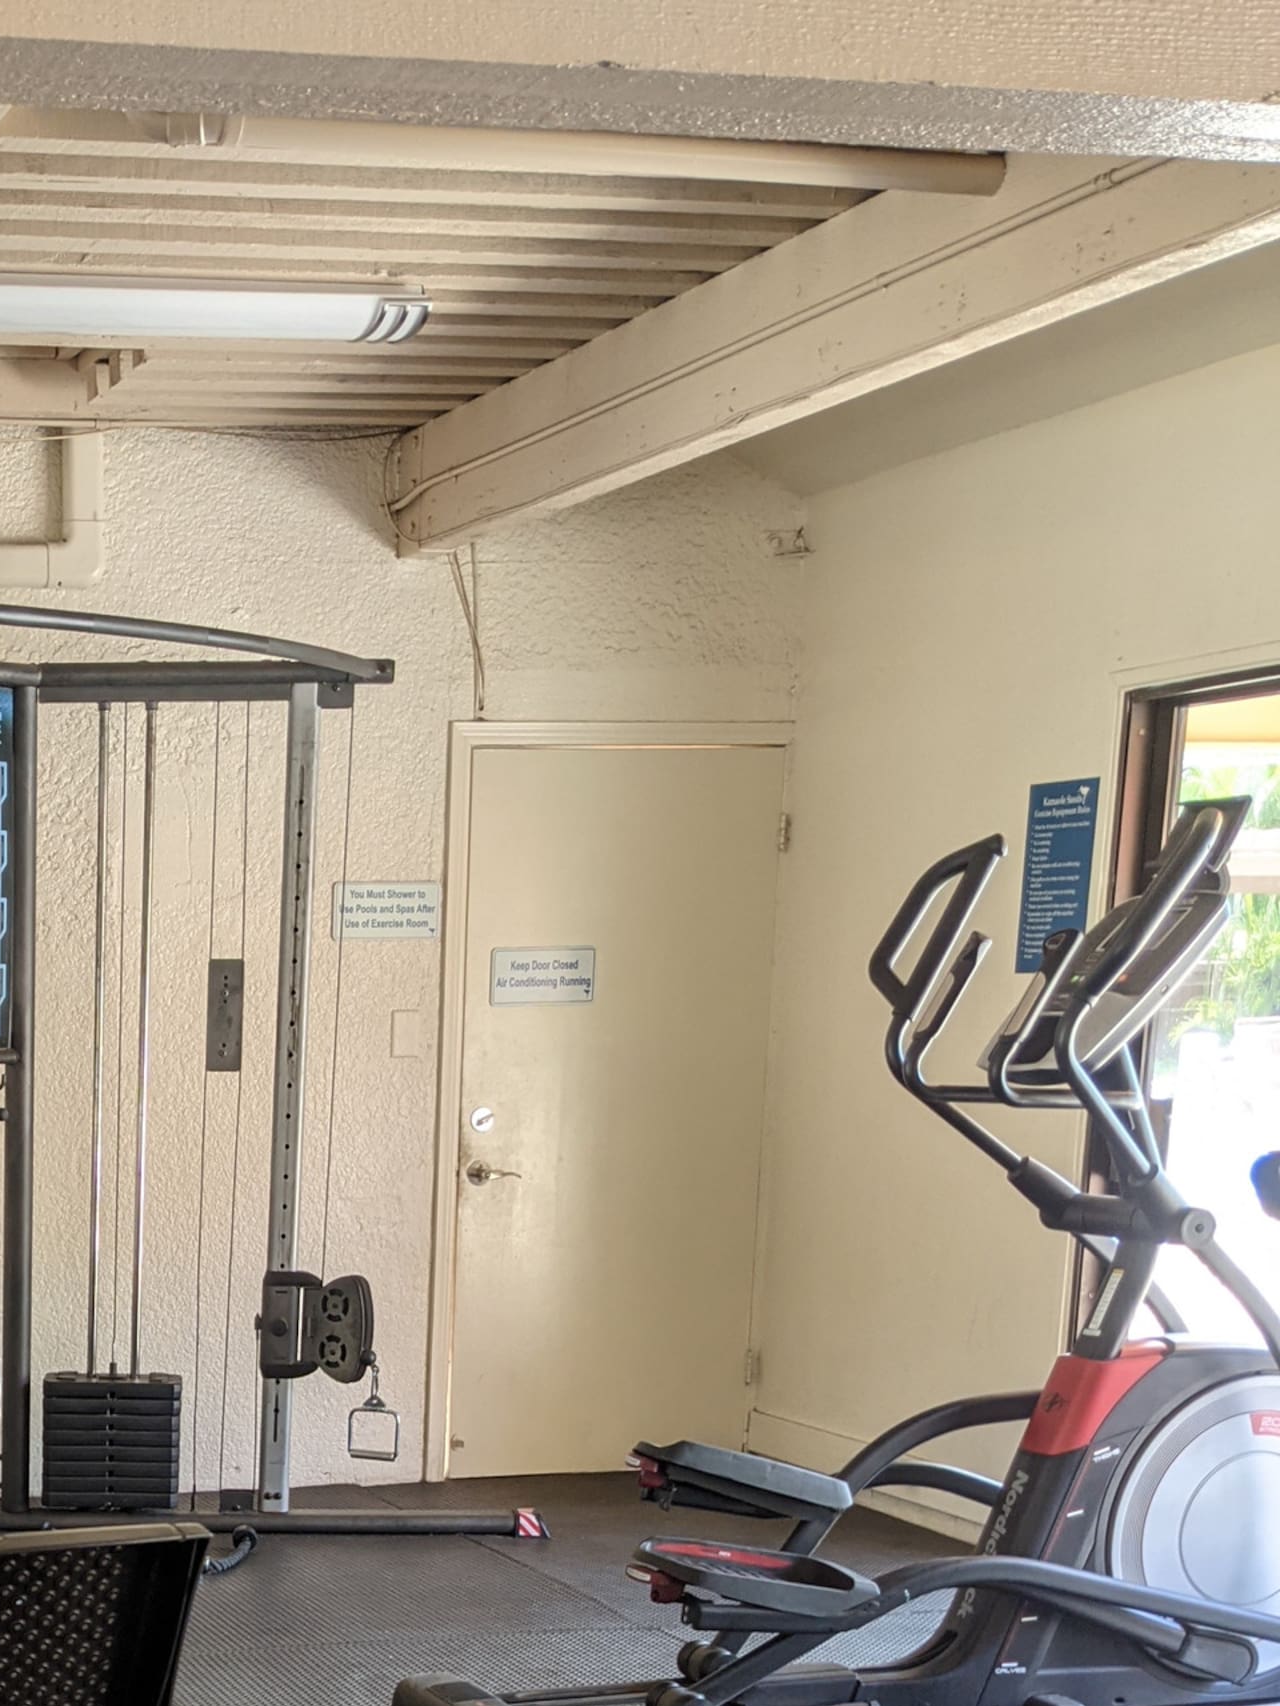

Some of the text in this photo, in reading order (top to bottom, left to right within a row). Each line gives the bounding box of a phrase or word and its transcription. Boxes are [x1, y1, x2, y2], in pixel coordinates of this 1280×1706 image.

[350, 889, 426, 899] You Must Shower to
[356, 904, 377, 914] Pools
[379, 904, 394, 914] and
[395, 904, 415, 915] Spas
[417, 904, 436, 914] After
[345, 919, 429, 929] Use of Exercise Room
[510, 959, 579, 972] Keep Door Closed
[496, 976, 591, 989] Air Conditioning Running
